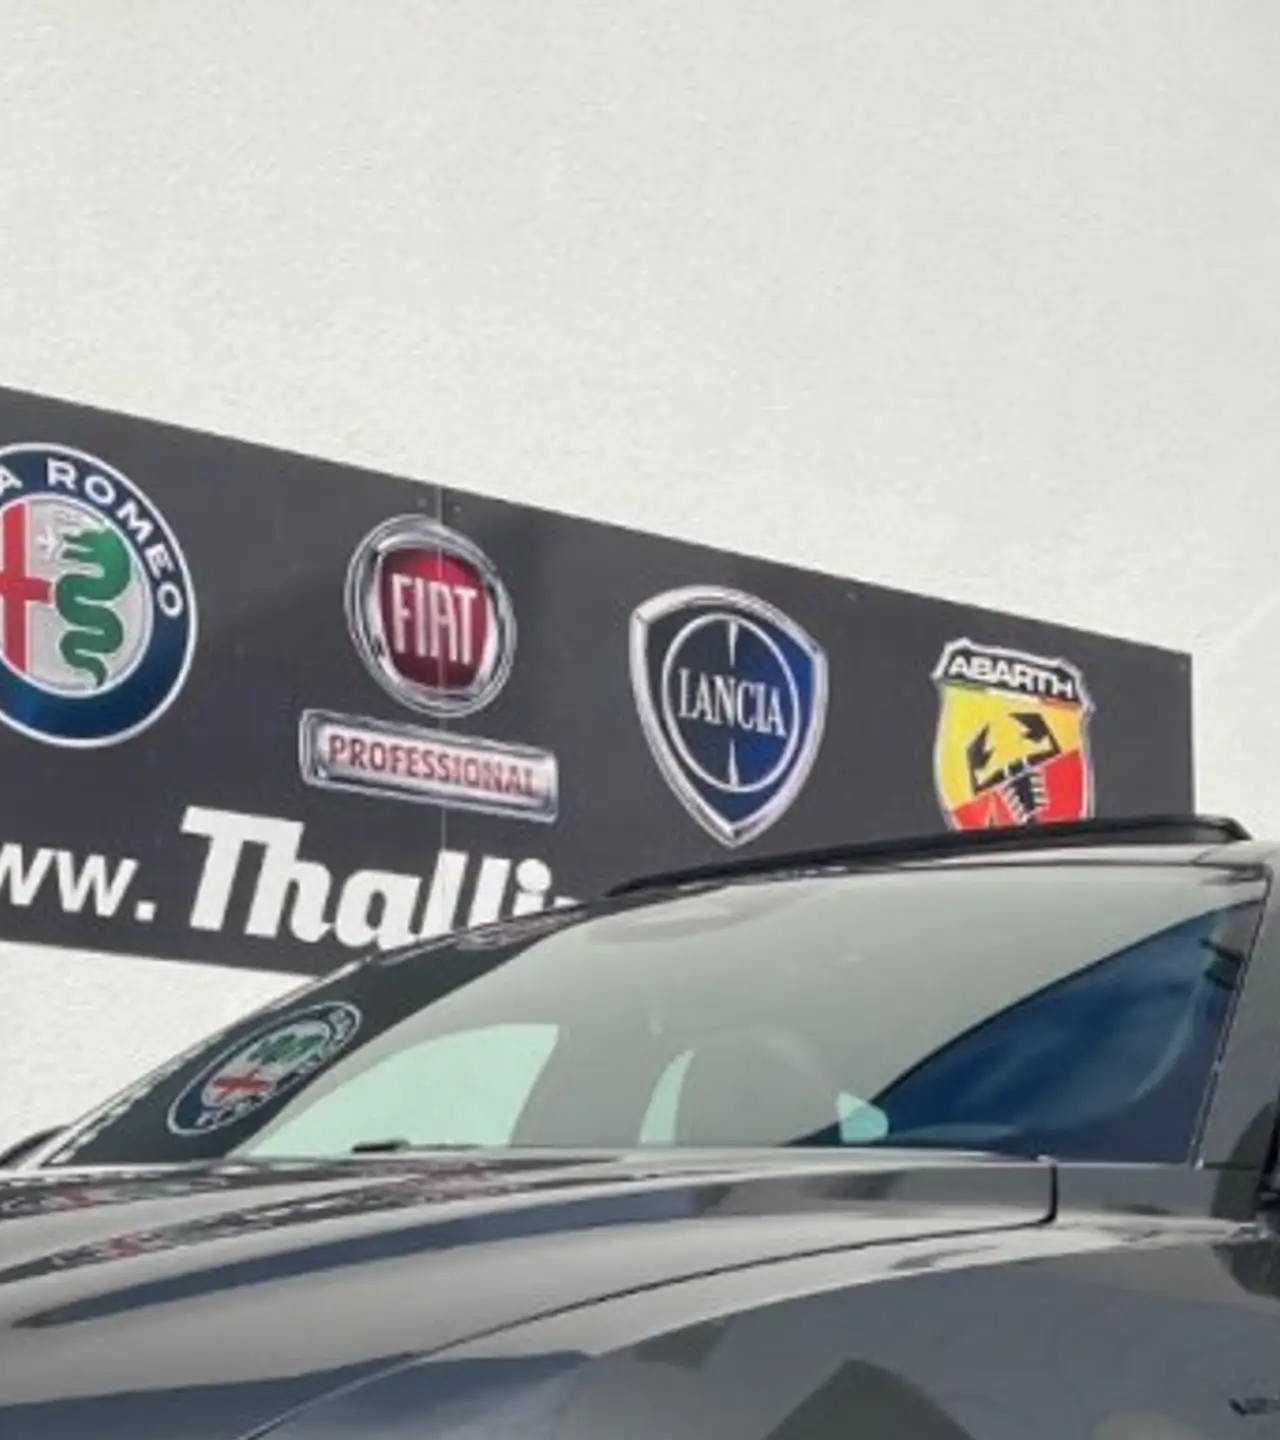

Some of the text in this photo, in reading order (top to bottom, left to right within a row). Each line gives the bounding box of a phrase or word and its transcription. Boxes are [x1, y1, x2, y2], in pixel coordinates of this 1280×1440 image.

[46, 457, 184, 618] ROMEO
[392, 573, 477, 665] FIAT
[678, 667, 787, 738] LANCIA
[949, 654, 1075, 699] ABARTH
[327, 734, 536, 796] PROFESSIONAL
[180, 805, 582, 952] Thalli
